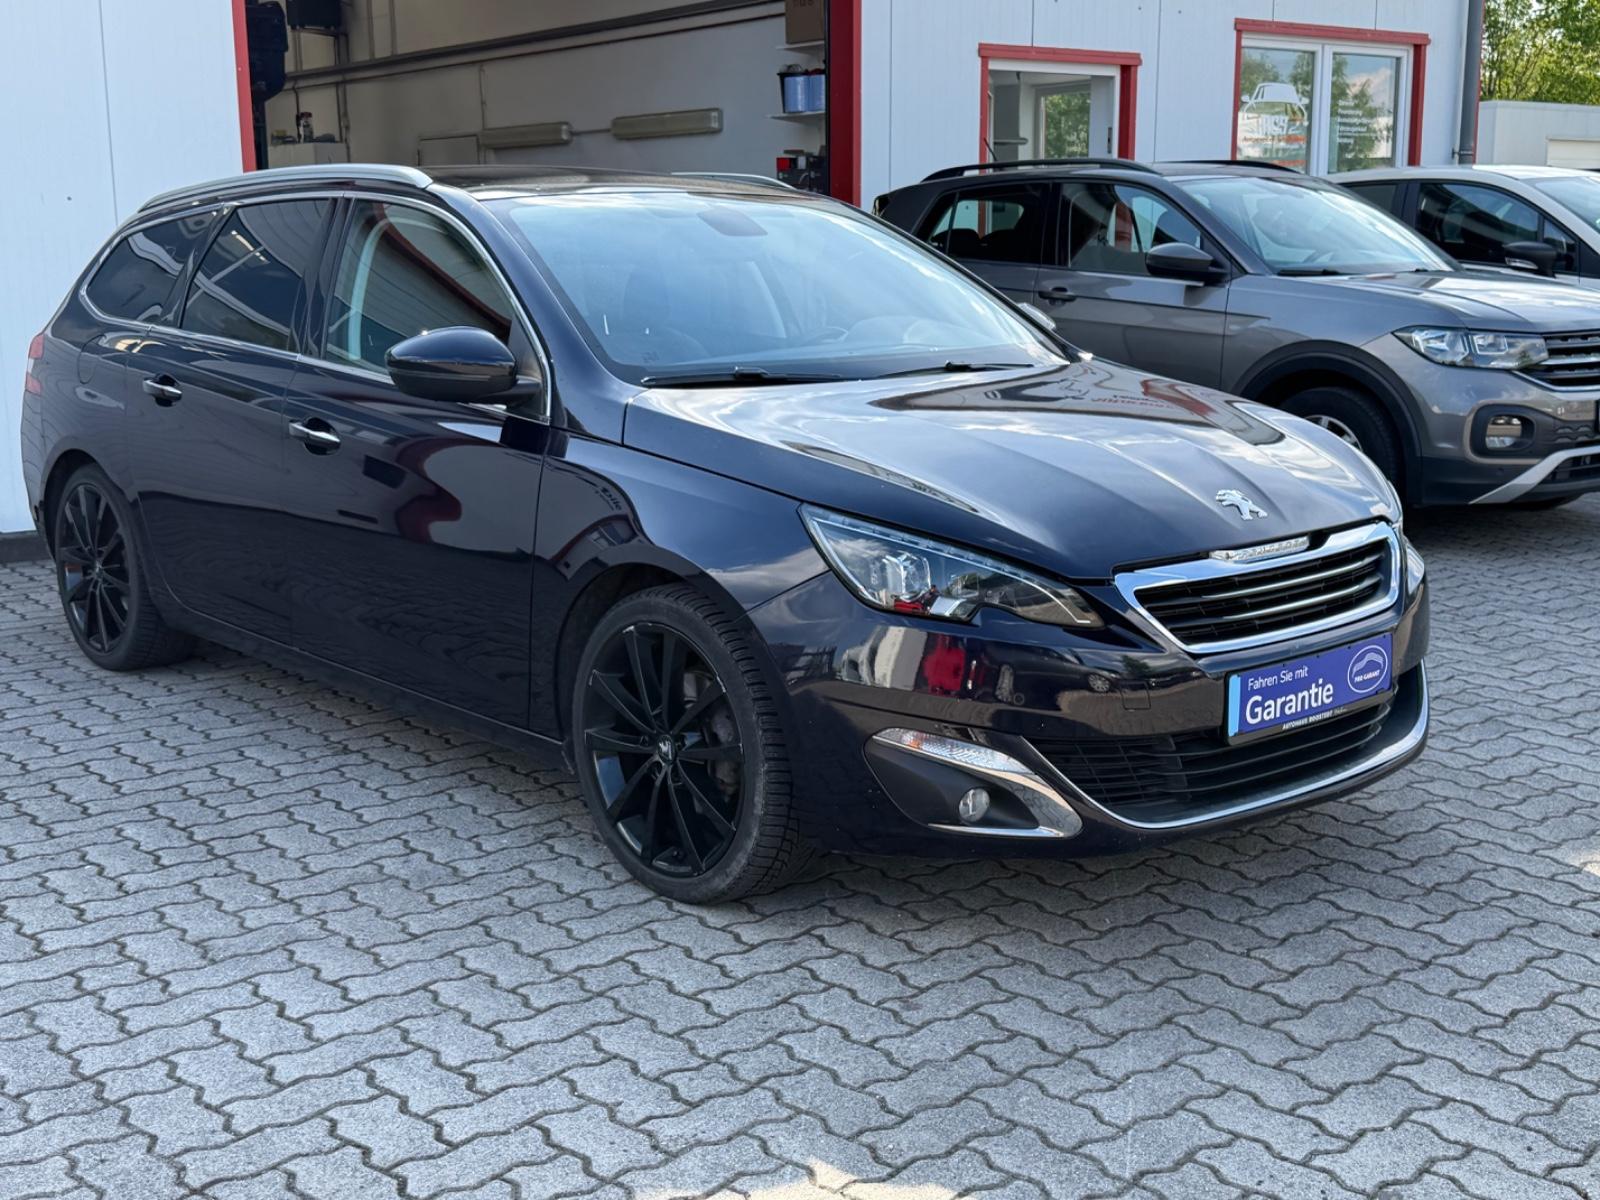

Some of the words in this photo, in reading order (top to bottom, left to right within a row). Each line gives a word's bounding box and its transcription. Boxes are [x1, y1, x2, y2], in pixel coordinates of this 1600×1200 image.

[1248, 675, 1277, 691] Fahren
[1280, 669, 1293, 683] Sie
[1295, 665, 1309, 679] mit
[1246, 678, 1334, 724] Garantie
